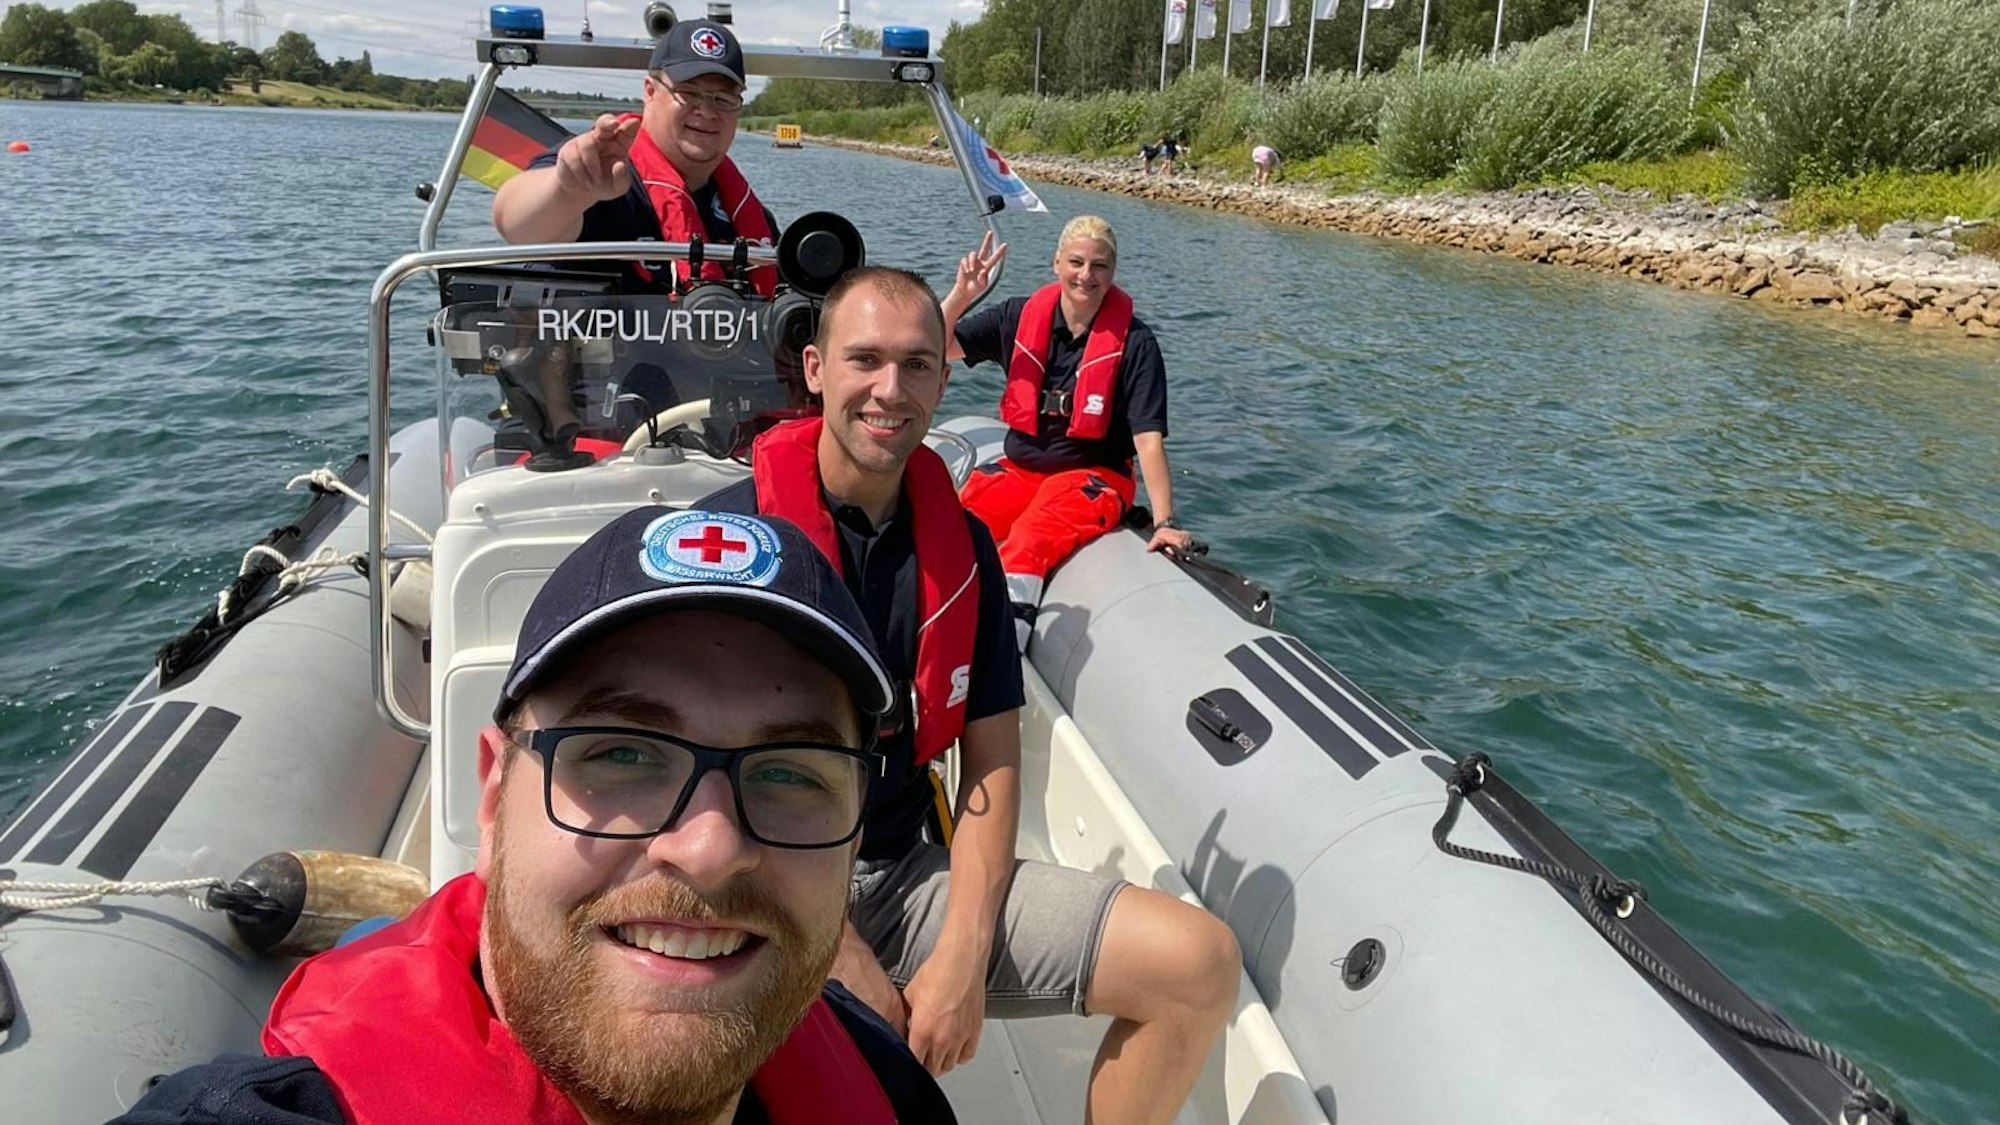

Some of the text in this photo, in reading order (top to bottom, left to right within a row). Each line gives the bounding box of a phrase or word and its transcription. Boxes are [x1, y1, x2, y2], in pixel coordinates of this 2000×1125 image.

[538, 308, 758, 345] RK/PUL/RTB/1
[651, 514, 705, 546] DEUTSCHES
[664, 563, 756, 581] WASSERWACHT
